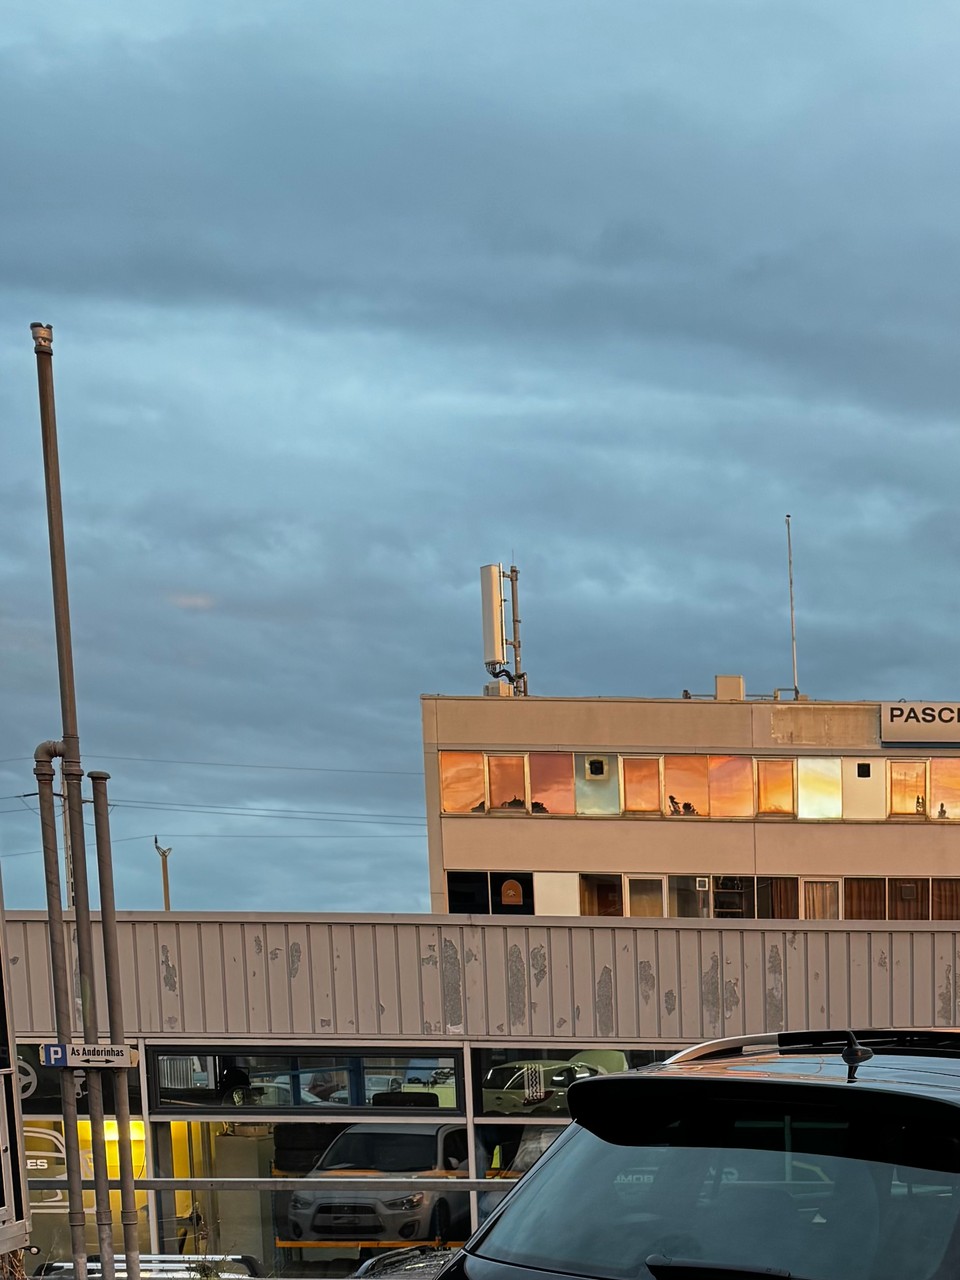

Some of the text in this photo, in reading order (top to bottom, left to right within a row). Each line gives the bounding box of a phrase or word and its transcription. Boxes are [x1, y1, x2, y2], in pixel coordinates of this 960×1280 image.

[49, 1046, 62, 1064] P
[71, 1046, 125, 1057] As Andorinhas
